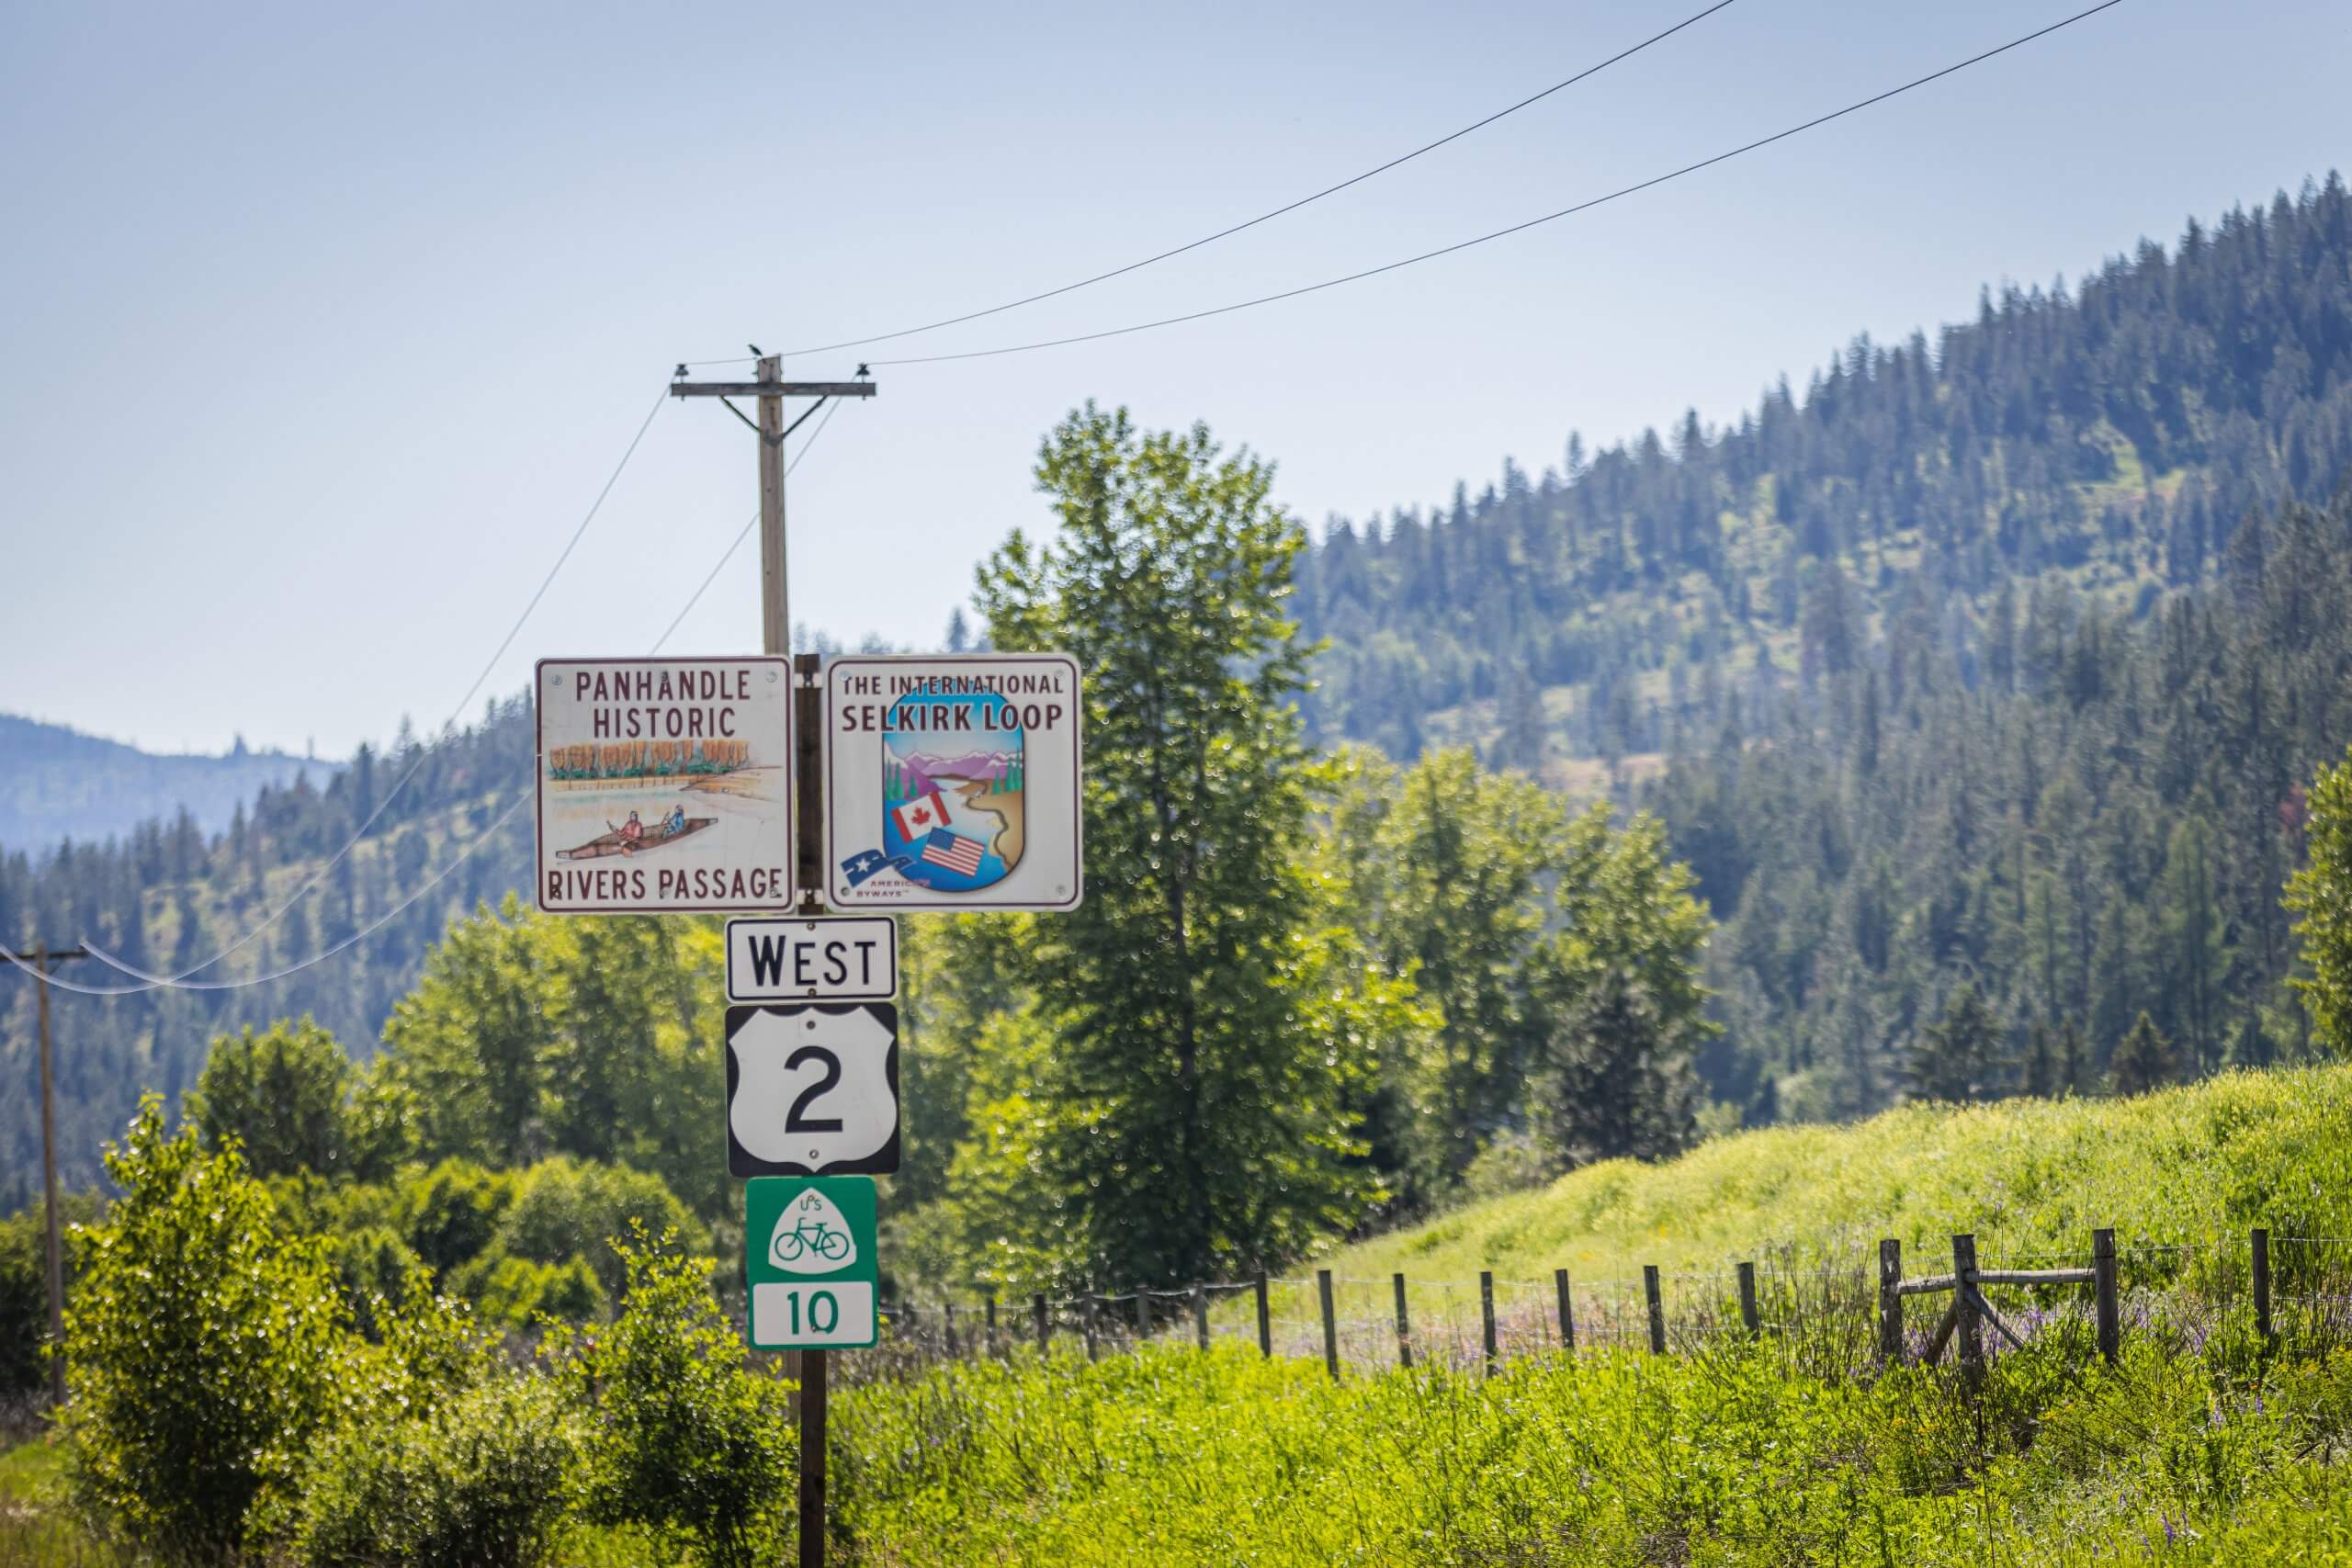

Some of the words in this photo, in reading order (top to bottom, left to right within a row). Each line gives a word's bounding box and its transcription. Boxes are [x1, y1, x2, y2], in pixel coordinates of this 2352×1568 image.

[576, 671, 751, 701] PANHANDLE
[842, 676, 881, 694] THE
[890, 675, 1064, 694] INTERNATIONAL
[594, 707, 736, 738] HISTORIC
[842, 705, 971, 731] SELKIRK
[984, 705, 1062, 730] LOOP
[548, 871, 646, 900] RIVERS
[659, 869, 783, 899] PASSAGE
[748, 935, 876, 987] WEST
[784, 1045, 843, 1134] 2
[800, 1199, 822, 1212] US
[787, 1291, 839, 1336] 10
